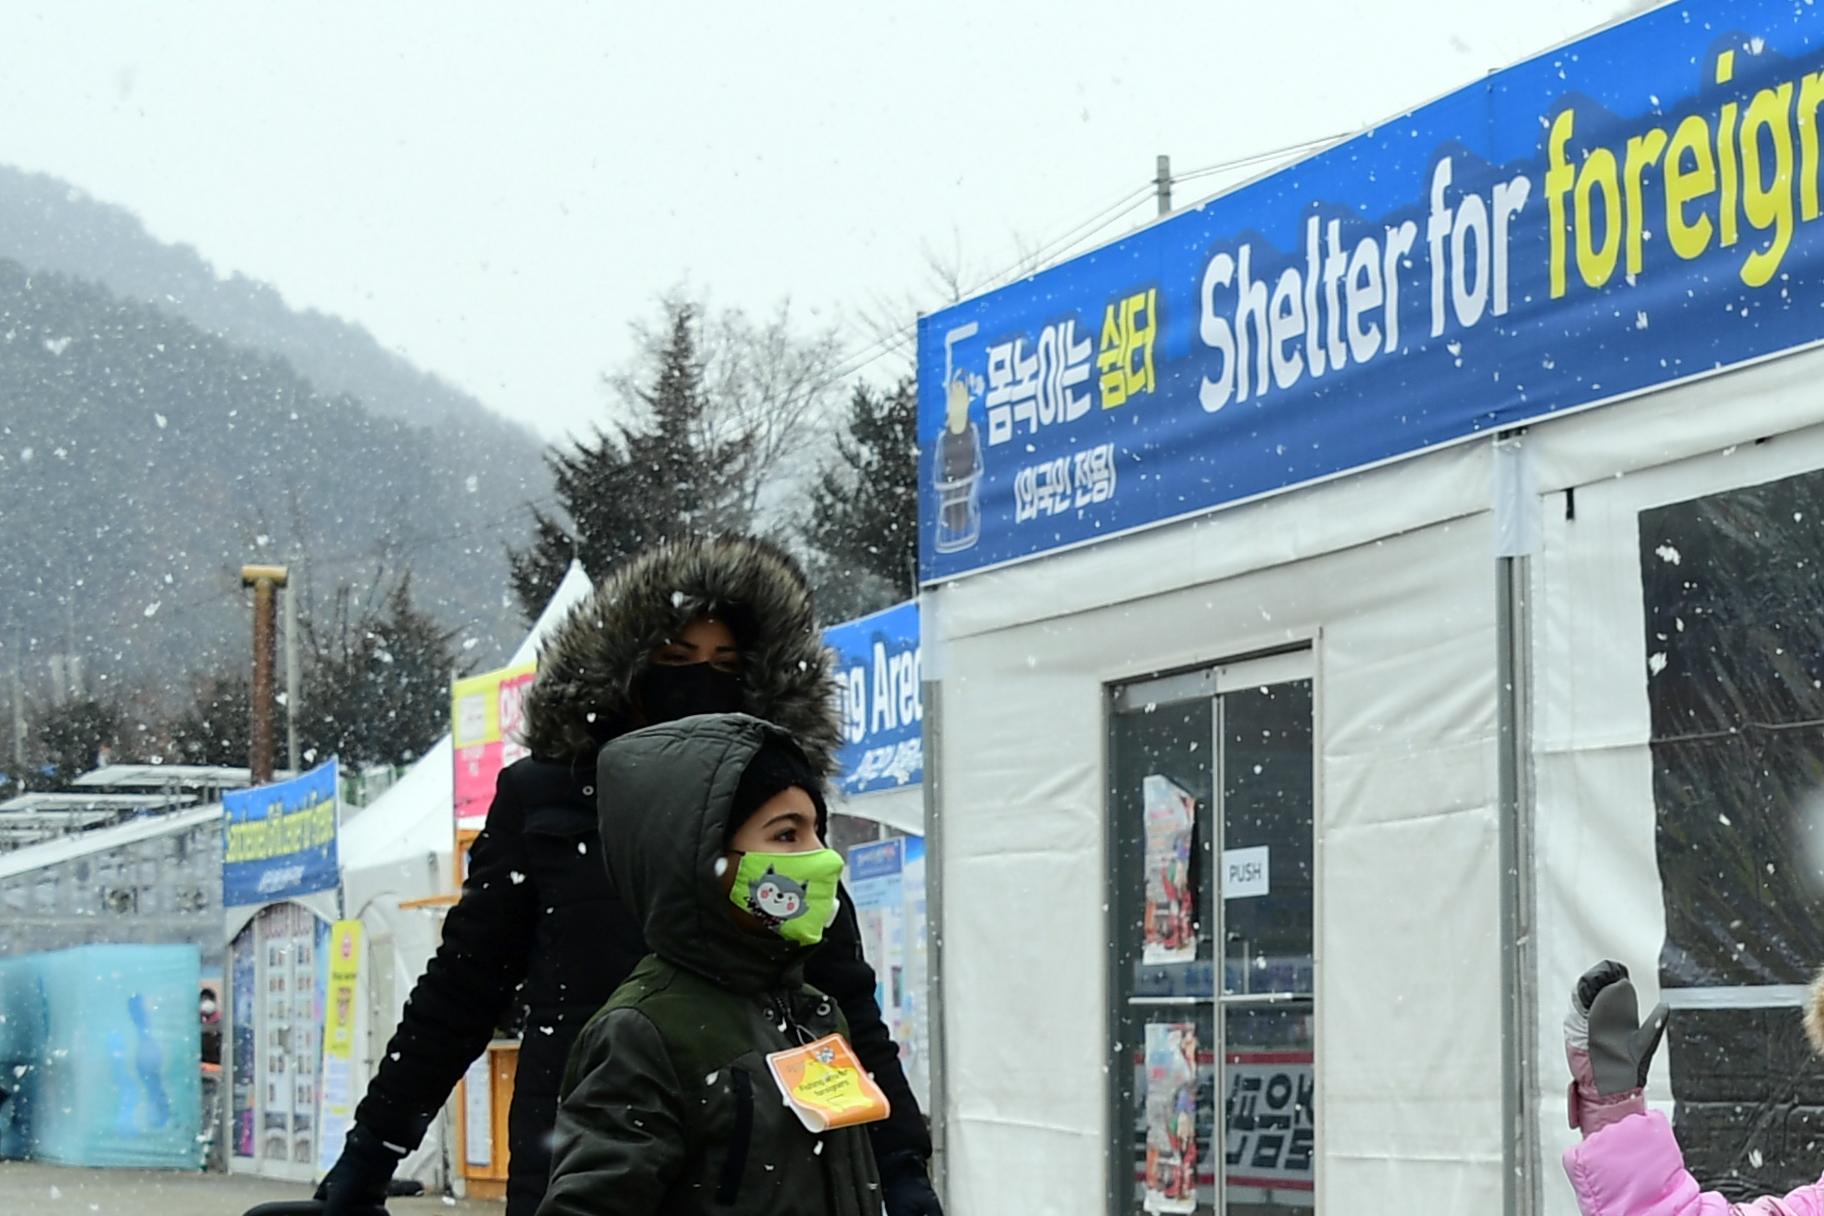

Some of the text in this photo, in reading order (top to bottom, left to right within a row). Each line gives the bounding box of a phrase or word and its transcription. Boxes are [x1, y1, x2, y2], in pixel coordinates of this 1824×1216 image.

[1199, 215, 1417, 413] Shelter
[1427, 156, 1531, 337] for
[986, 288, 1156, 446] 몸녹이는 쉼터
[1014, 442, 1117, 524] (외국인 전용)
[1229, 862, 1262, 882] PUSH
